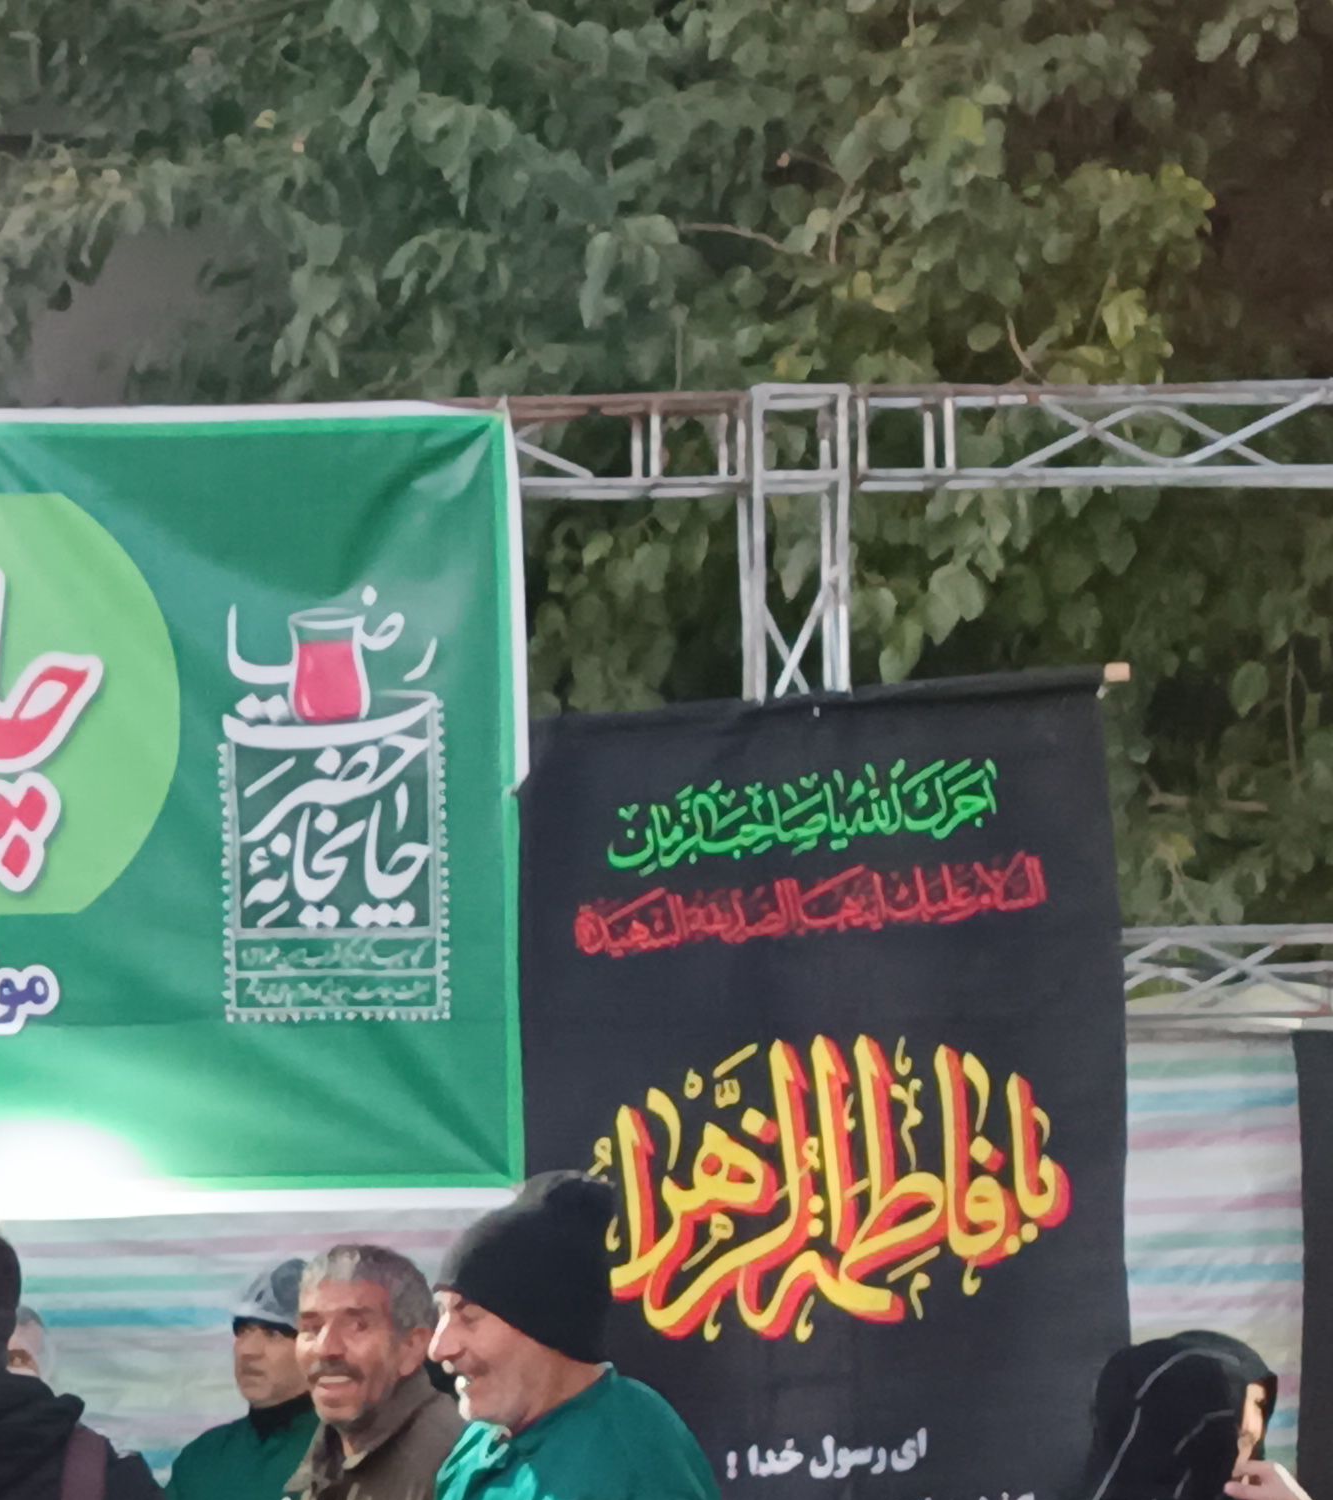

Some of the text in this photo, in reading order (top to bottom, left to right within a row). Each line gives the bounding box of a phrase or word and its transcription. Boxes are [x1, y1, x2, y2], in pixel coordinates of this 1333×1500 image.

[747, 1437, 805, 1477] خدا
[809, 1434, 887, 1480] رسول
[890, 1427, 928, 1472] ای
